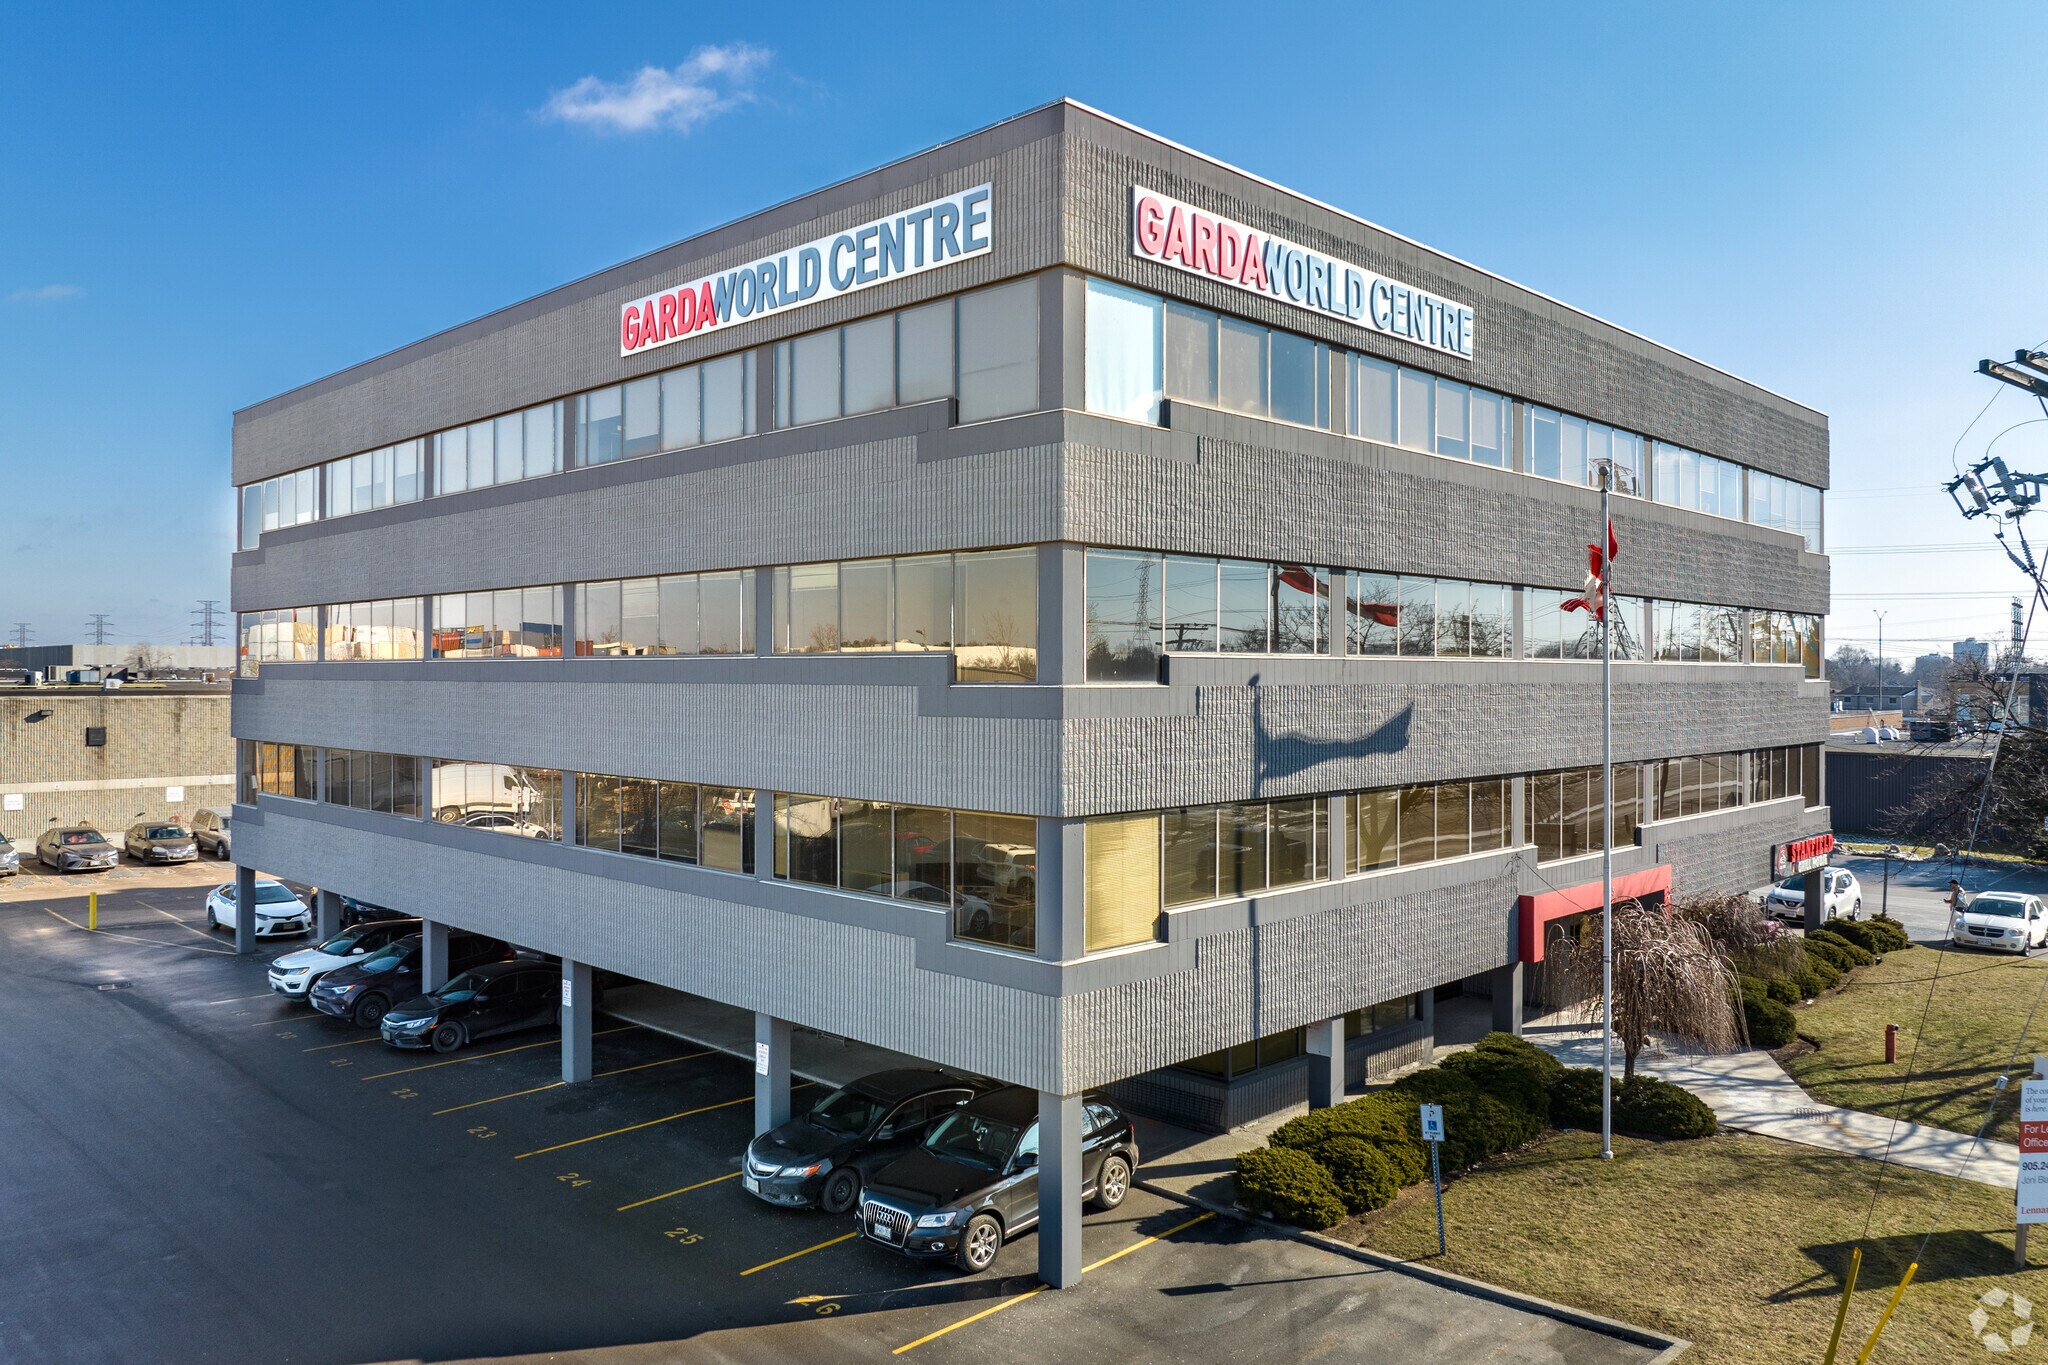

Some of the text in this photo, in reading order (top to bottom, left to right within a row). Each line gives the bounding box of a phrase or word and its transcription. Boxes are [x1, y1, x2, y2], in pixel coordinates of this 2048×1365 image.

[622, 188, 989, 351] GARDAWORLD CENTRE
[1137, 196, 1474, 357] GARDAWORLD CENTRE
[1791, 834, 1834, 862] STANFIELD
[392, 1088, 419, 1100] 22
[2026, 1087, 2038, 1095] The
[2025, 1096, 2033, 1104] of
[467, 1125, 498, 1140] 23
[2024, 1124, 2039, 1134] For
[557, 1172, 592, 1188] 24
[663, 1226, 705, 1245] 25
